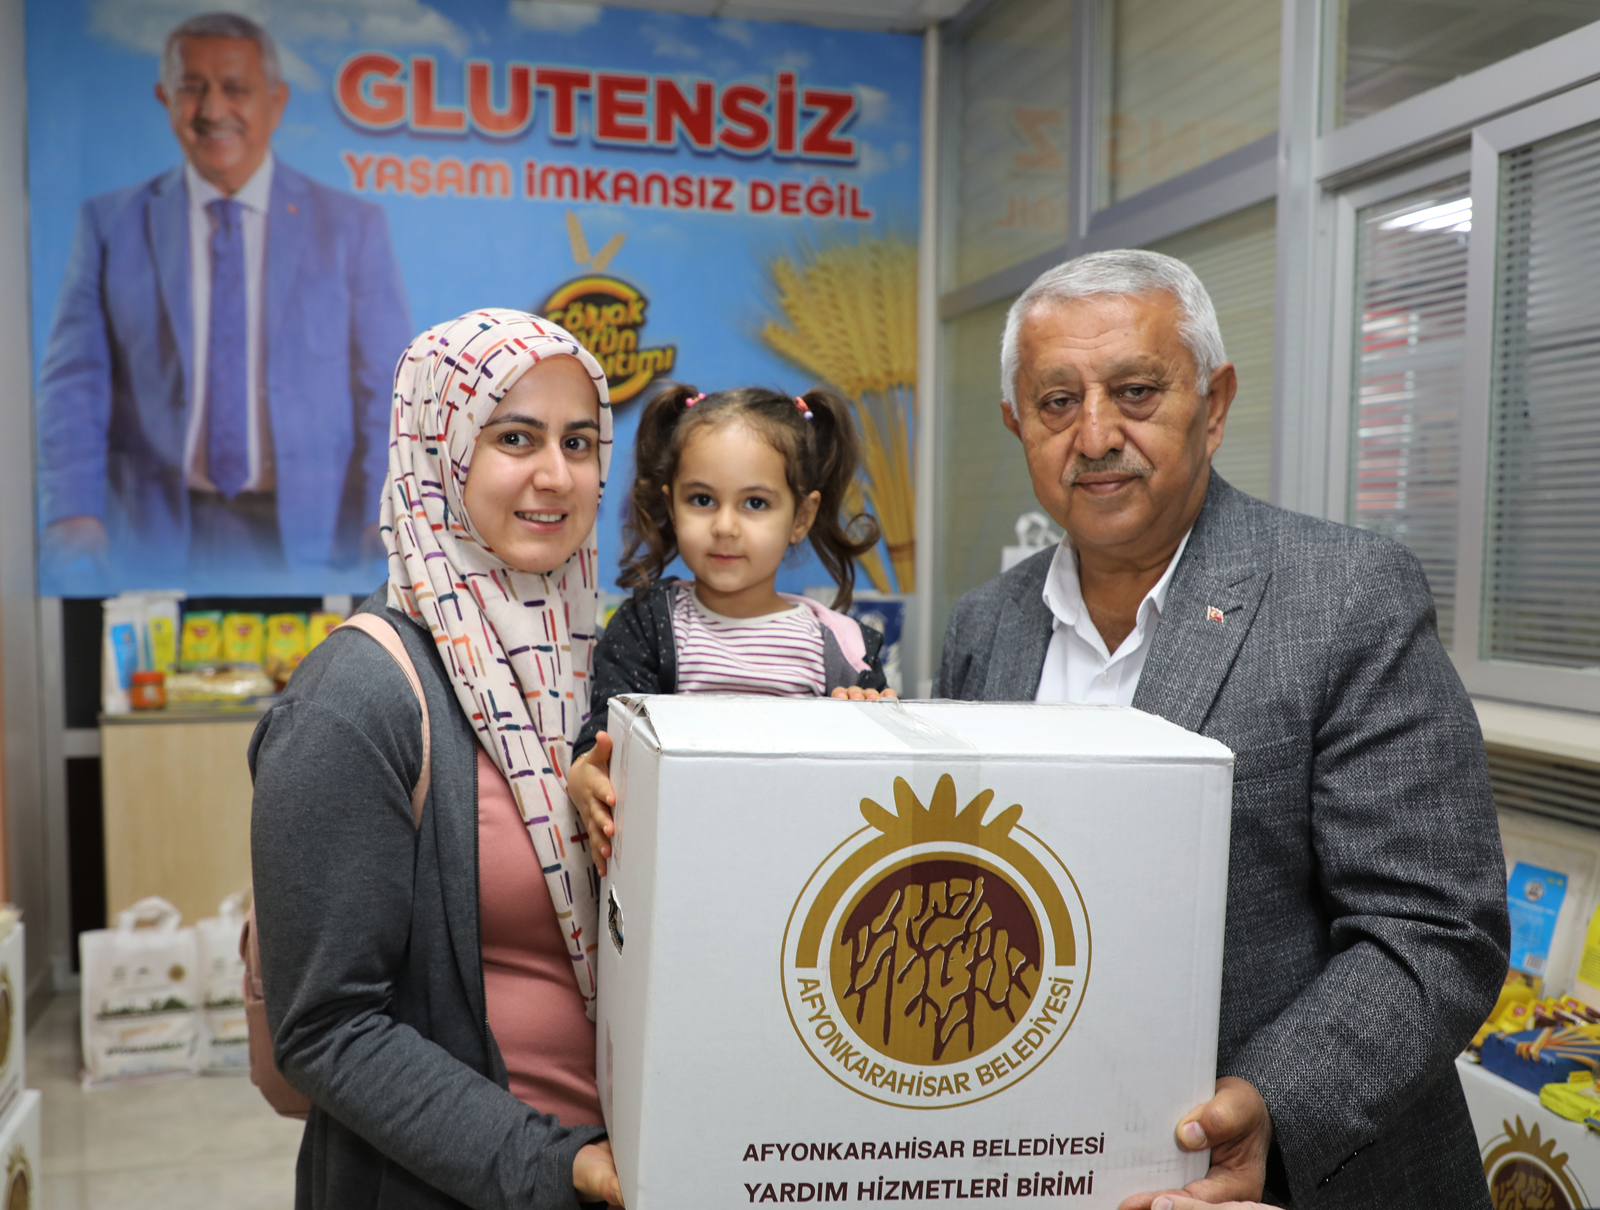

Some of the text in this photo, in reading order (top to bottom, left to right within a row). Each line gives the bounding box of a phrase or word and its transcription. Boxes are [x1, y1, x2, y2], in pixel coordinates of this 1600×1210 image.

[337, 54, 855, 156] GLUTENSİZ
[344, 153, 872, 219] YAŞAM İMKANSIZ DEĞİL
[797, 976, 1074, 1097] AFYONKARAHİSAR BELEDİYESİ
[742, 1132, 1105, 1161] AFYONKARAHİSAR BELEDİYESİ
[743, 1170, 1094, 1203] YARDIM HİZMETLERİ BİRİMİ
